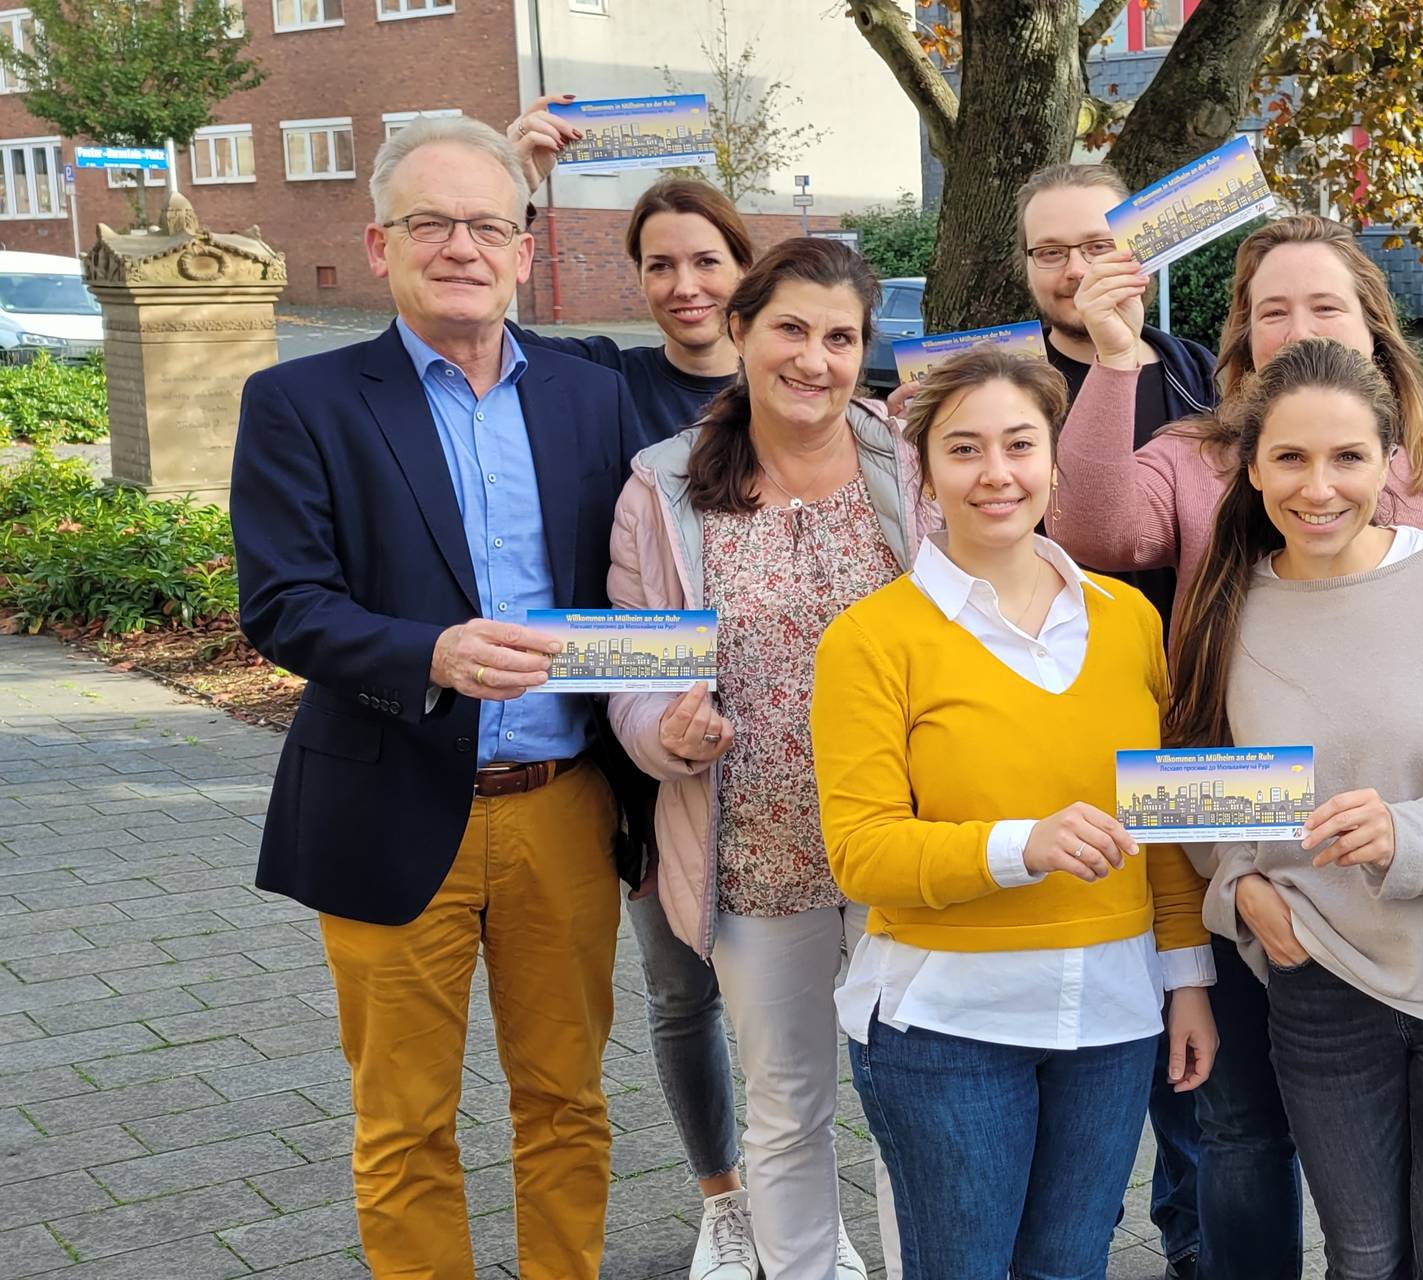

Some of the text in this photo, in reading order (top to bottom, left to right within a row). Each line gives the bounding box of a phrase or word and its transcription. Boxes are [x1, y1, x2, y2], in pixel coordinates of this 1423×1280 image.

[1155, 755, 1196, 763] Willkommen
[1206, 754, 1234, 762] Mülheim
[1246, 753, 1256, 761] der
